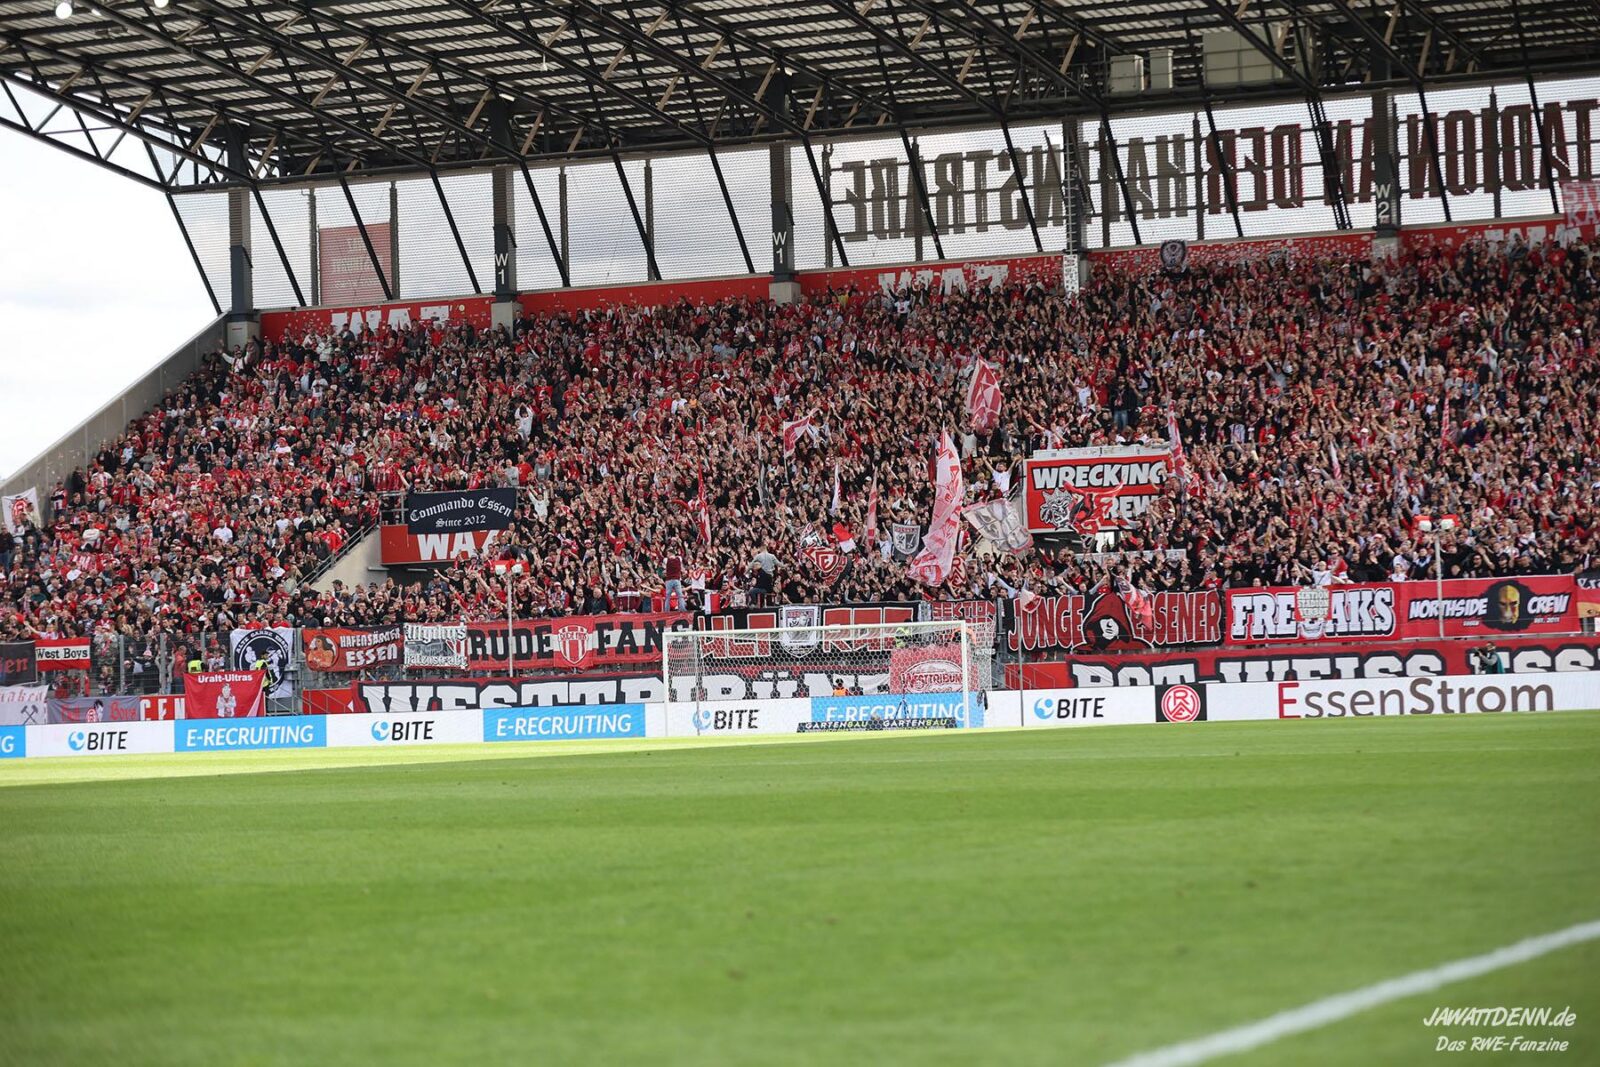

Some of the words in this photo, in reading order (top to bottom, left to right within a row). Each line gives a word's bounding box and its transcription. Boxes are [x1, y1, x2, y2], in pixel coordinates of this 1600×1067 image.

[1032, 462, 1167, 489] WRECKING
[410, 497, 475, 522] Commando
[478, 496, 512, 518] Essen
[436, 518, 462, 528] Since
[464, 514, 487, 526] 2012
[1408, 597, 1489, 620] NORTHSIDE
[1526, 594, 1570, 614] CREW
[1008, 595, 1085, 651] JUNGE
[36, 647, 60, 659] West
[63, 647, 88, 659] Boys
[468, 625, 554, 661] RUDE
[198, 674, 253, 683] Uralt-Ultras
[1057, 697, 1106, 719] BITE
[1278, 677, 1554, 719] EssenStrom
[391, 720, 435, 741] BITE
[497, 713, 632, 736] E-RECRUITING
[714, 709, 760, 730] BITE
[805, 721, 868, 730] GARTENBAU
[882, 718, 947, 727] GARTENBAU
[87, 731, 128, 750] BITE
[186, 724, 313, 747] E-RECRUITING
